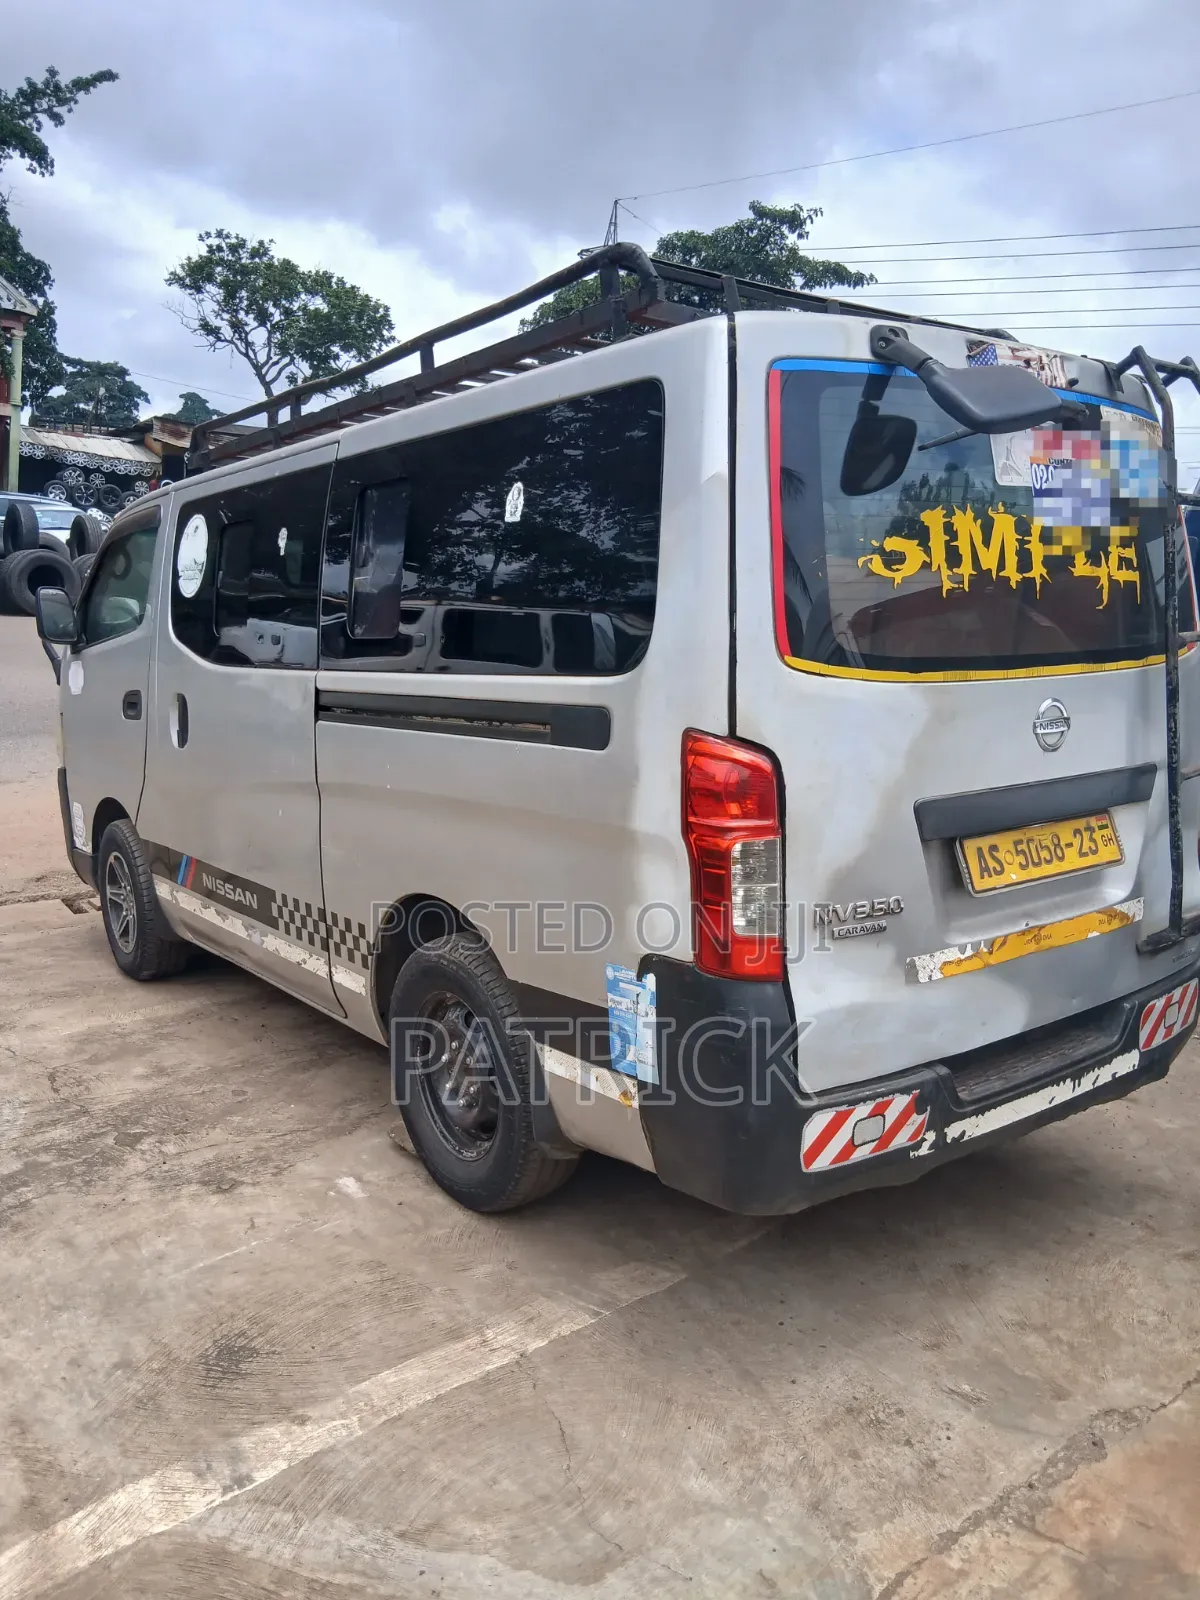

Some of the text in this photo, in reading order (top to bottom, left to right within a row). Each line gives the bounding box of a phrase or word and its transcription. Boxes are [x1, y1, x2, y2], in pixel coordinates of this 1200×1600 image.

[1039, 718, 1069, 732] NISSAN
[976, 823, 1100, 880] AS 5058-23
[1101, 832, 1115, 847] GH
[202, 872, 258, 910] NISSAN
[813, 895, 905, 928] NV350
[838, 922, 884, 938] CARAVAN
